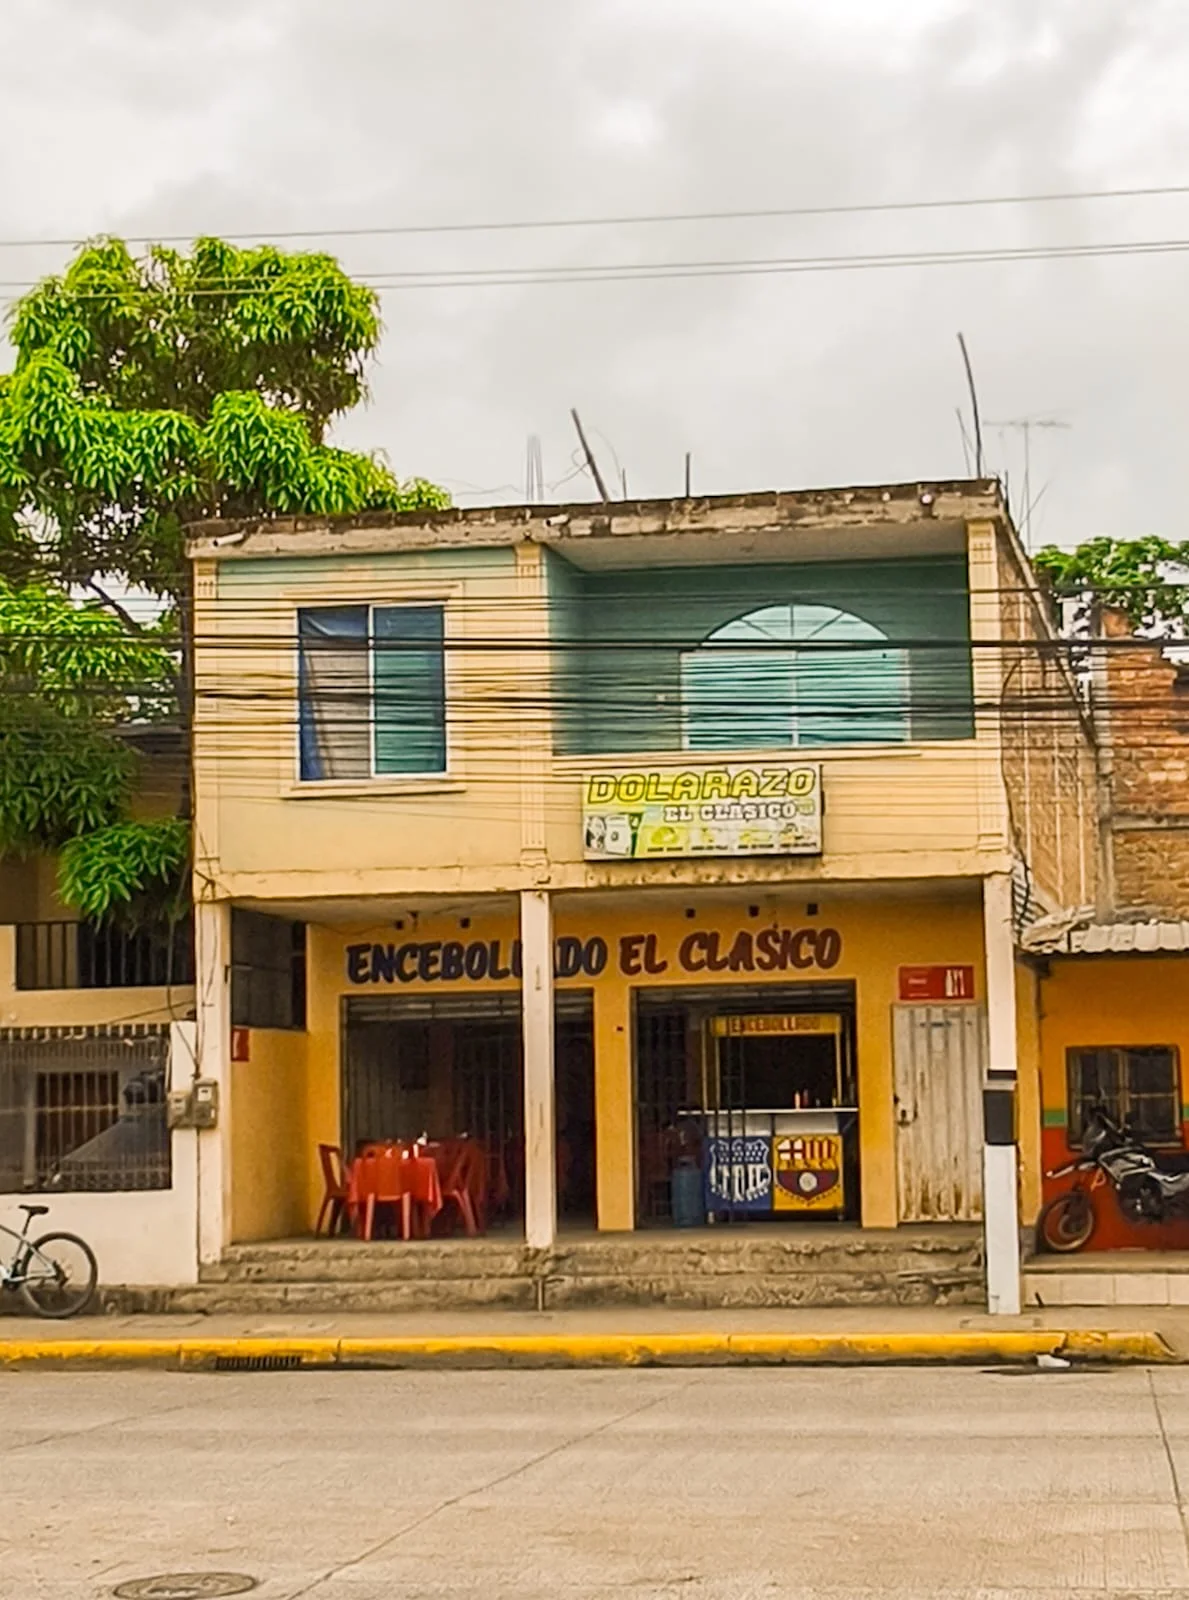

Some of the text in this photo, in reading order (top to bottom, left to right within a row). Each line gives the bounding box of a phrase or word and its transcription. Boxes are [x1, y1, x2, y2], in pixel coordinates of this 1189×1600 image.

[587, 767, 816, 804] DOLARAZO
[664, 804, 693, 822] EL
[700, 801, 797, 820] CLASICO
[346, 927, 842, 984] ENCEBOLLDO EL CLASICO
